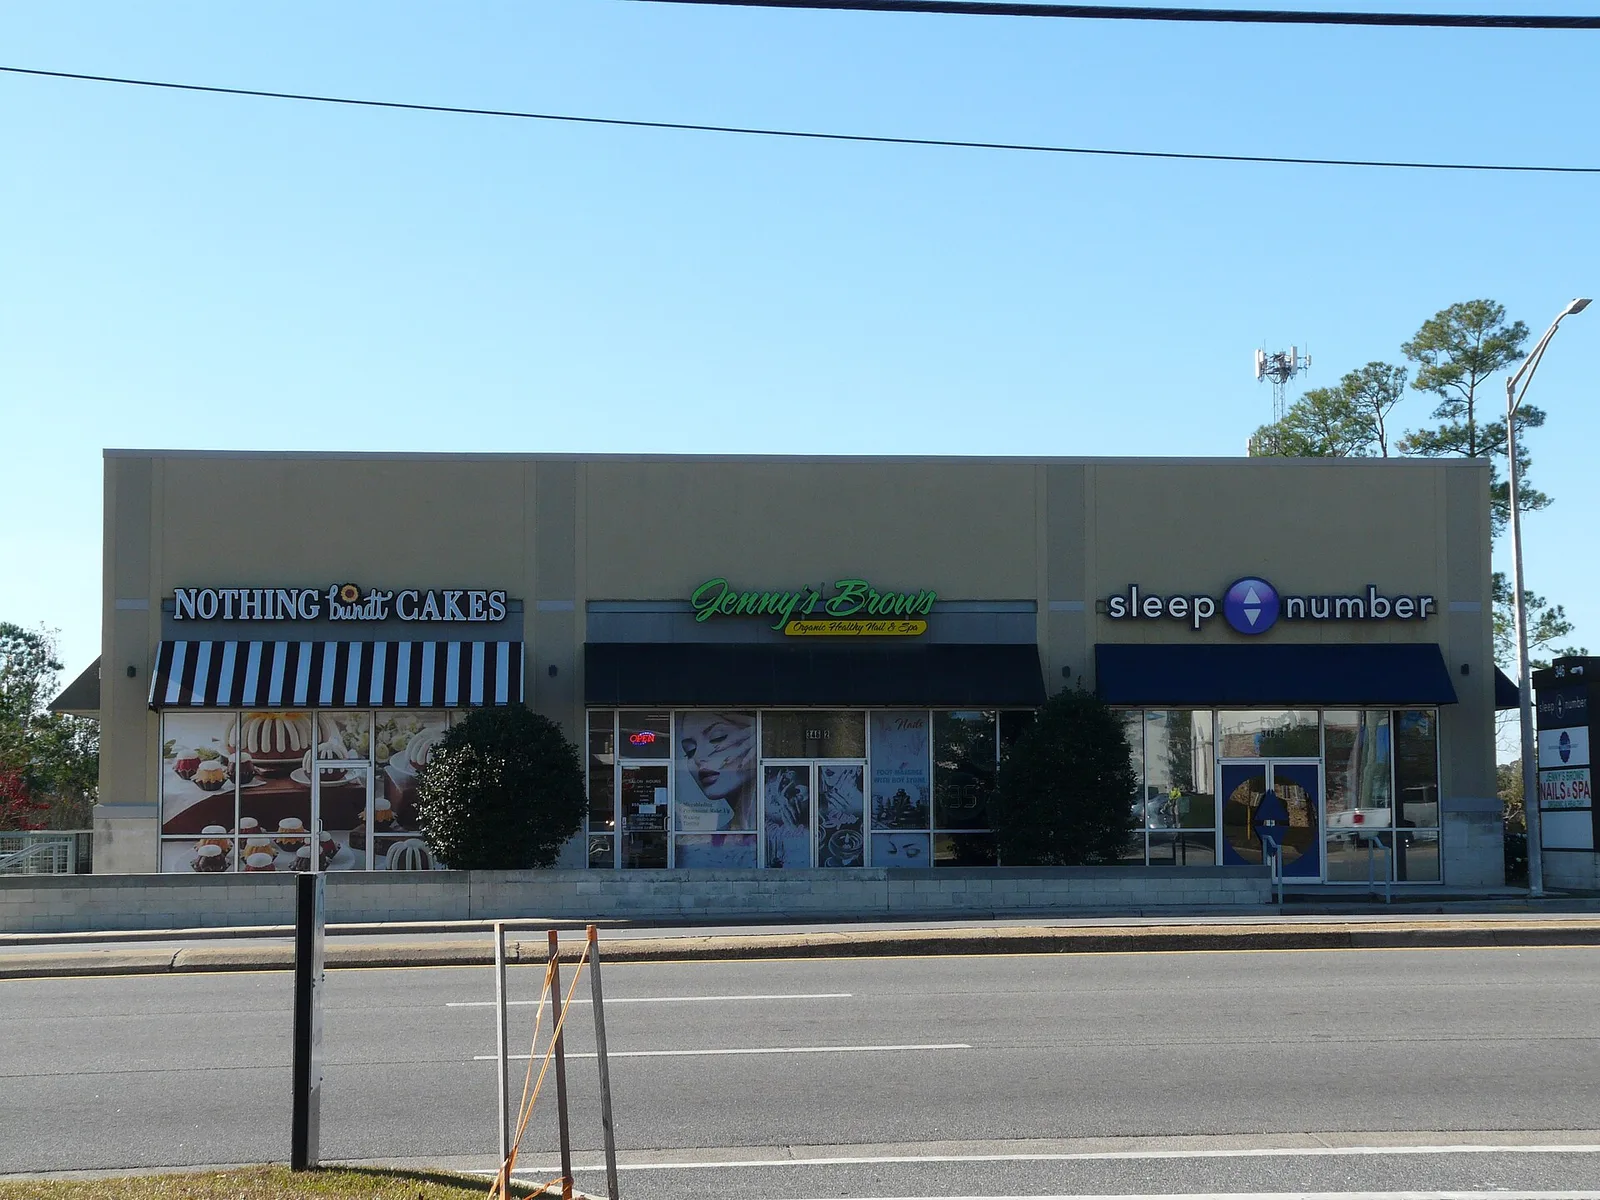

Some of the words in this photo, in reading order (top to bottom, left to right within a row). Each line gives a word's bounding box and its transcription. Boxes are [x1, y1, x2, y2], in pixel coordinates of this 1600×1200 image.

[173, 588, 320, 620] NOTHING
[325, 584, 393, 621] bundt
[395, 590, 507, 622] CAKES
[690, 577, 821, 631] Jenny's
[824, 578, 938, 617] Brows
[1109, 586, 1215, 629] sleep
[1286, 586, 1434, 619] number
[793, 622, 826, 634] Organic
[828, 622, 864, 635] Healthy
[866, 622, 885, 632] Nail
[887, 622, 896, 632] &
[898, 622, 919, 634] Spa
[1539, 701, 1555, 715] sleep
[1564, 696, 1587, 710] number
[894, 717, 924, 731] Nails
[629, 734, 656, 743] OPEN
[1540, 782, 1566, 800] NAILS
[1572, 780, 1591, 800] SPA
